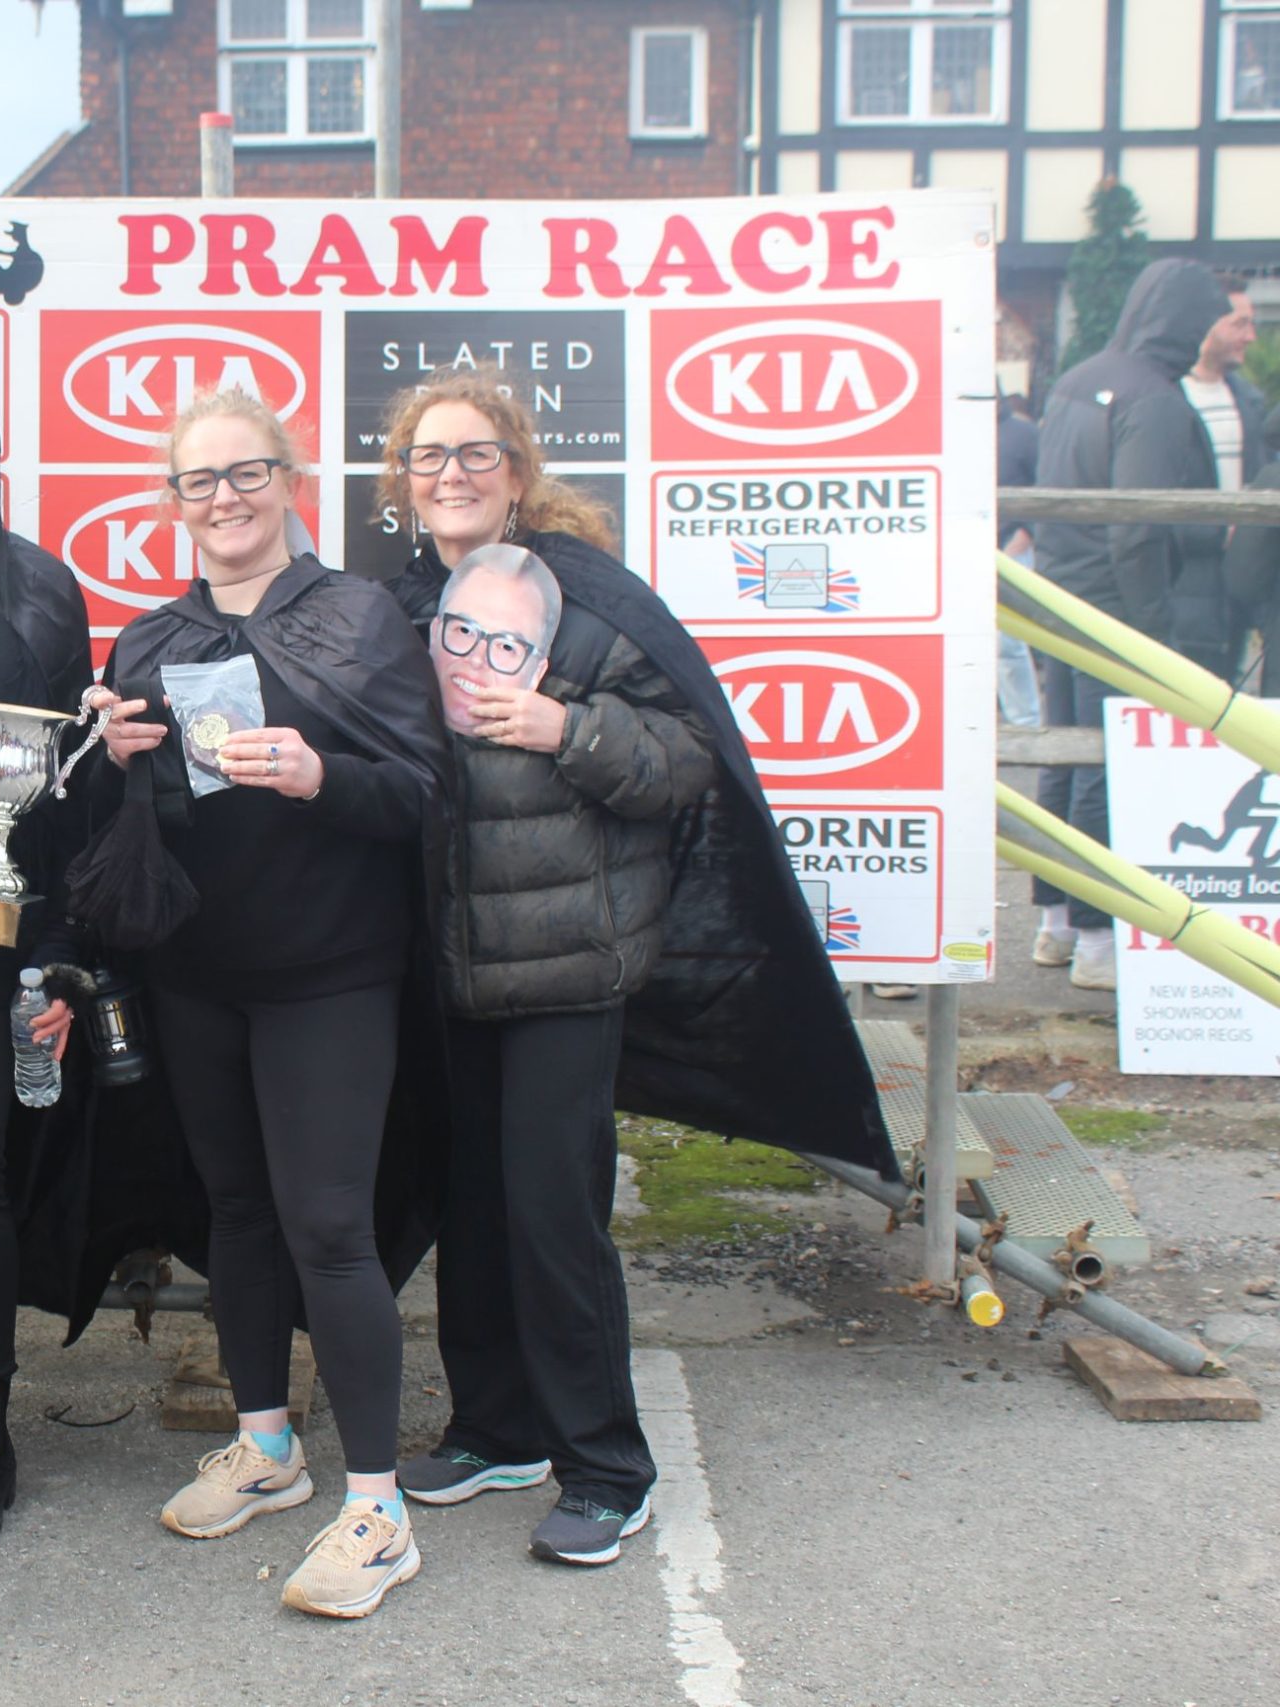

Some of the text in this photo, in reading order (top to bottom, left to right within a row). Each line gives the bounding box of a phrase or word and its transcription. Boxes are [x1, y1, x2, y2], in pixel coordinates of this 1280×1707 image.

[119, 212, 489, 297] PRAM
[540, 205, 900, 298] RACE
[382, 341, 593, 371] SLATED
[708, 348, 878, 414] KIA
[666, 477, 926, 513] OSBORNE
[667, 515, 927, 538] REFRIGERATORS
[104, 520, 194, 581] KI
[719, 681, 880, 743] KIA
[776, 816, 927, 849] ORNE
[1149, 985, 1235, 999] NEW BARN
[1143, 1006, 1243, 1021] SHOWROOM
[1134, 1027, 1254, 1042] BOGNOR REGIS
